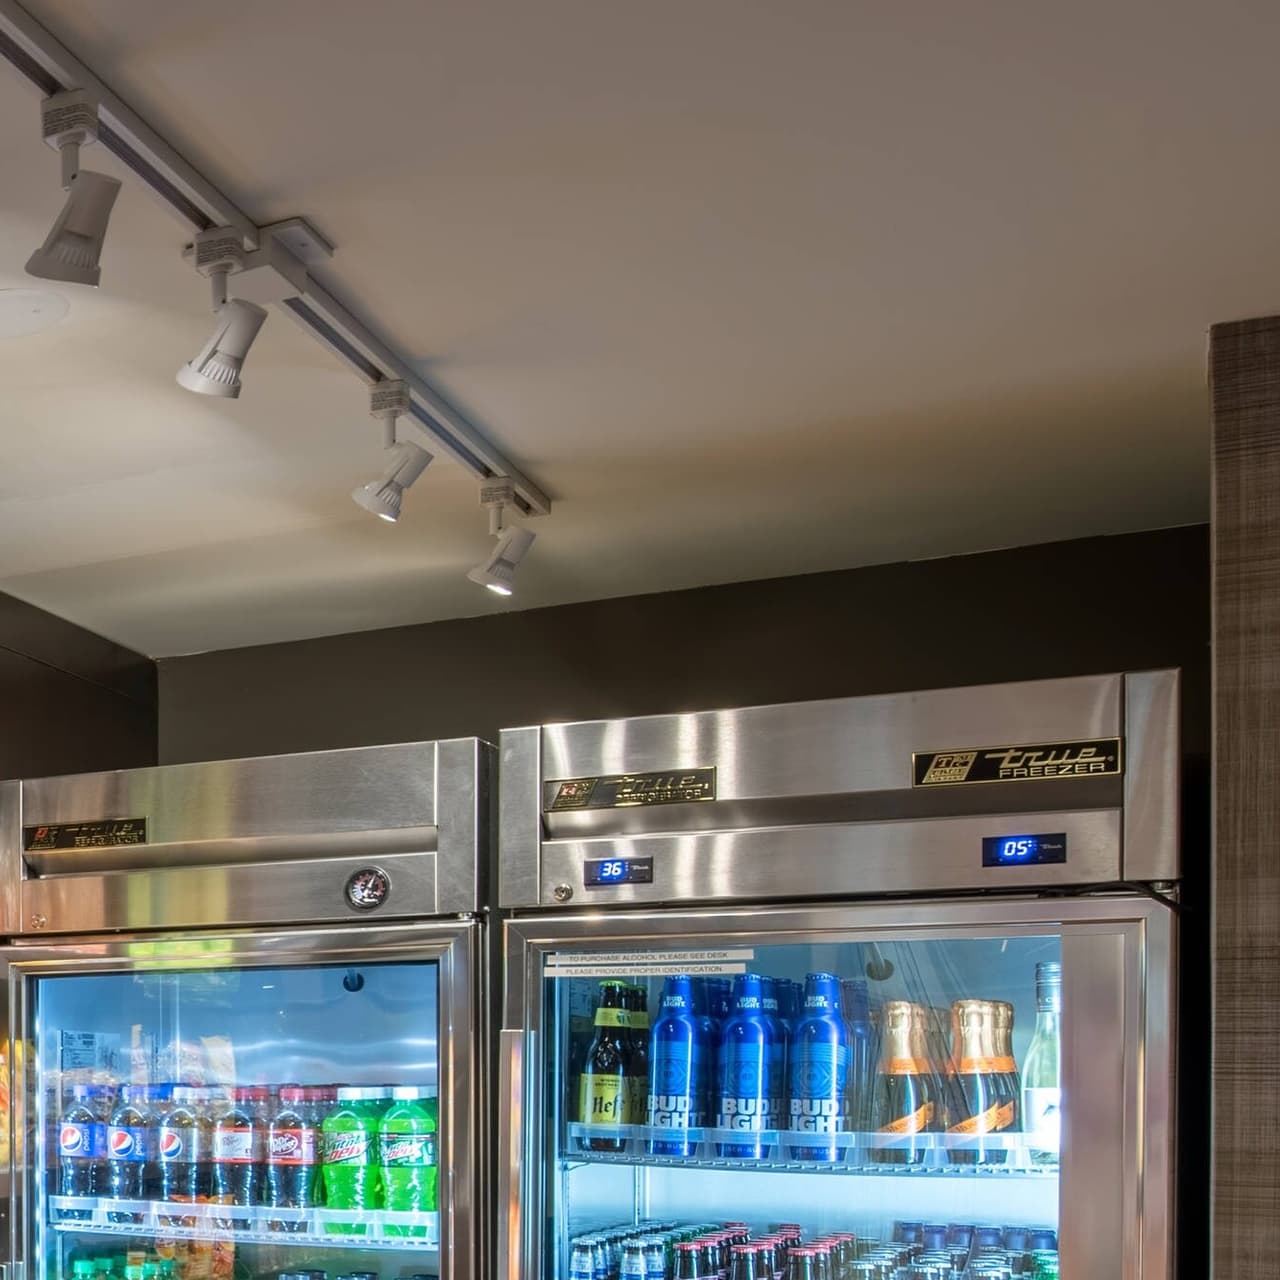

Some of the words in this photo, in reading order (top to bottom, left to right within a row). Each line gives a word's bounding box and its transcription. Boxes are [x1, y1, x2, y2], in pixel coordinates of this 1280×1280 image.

[984, 748, 1106, 768] true
[999, 763, 1105, 778] FREEZER
[602, 862, 622, 876] 36
[707, 951, 729, 959] DESK
[647, 1096, 693, 1112] BUD
[790, 1100, 839, 1116] BUD
[82, 1128, 90, 1152] pepsi
